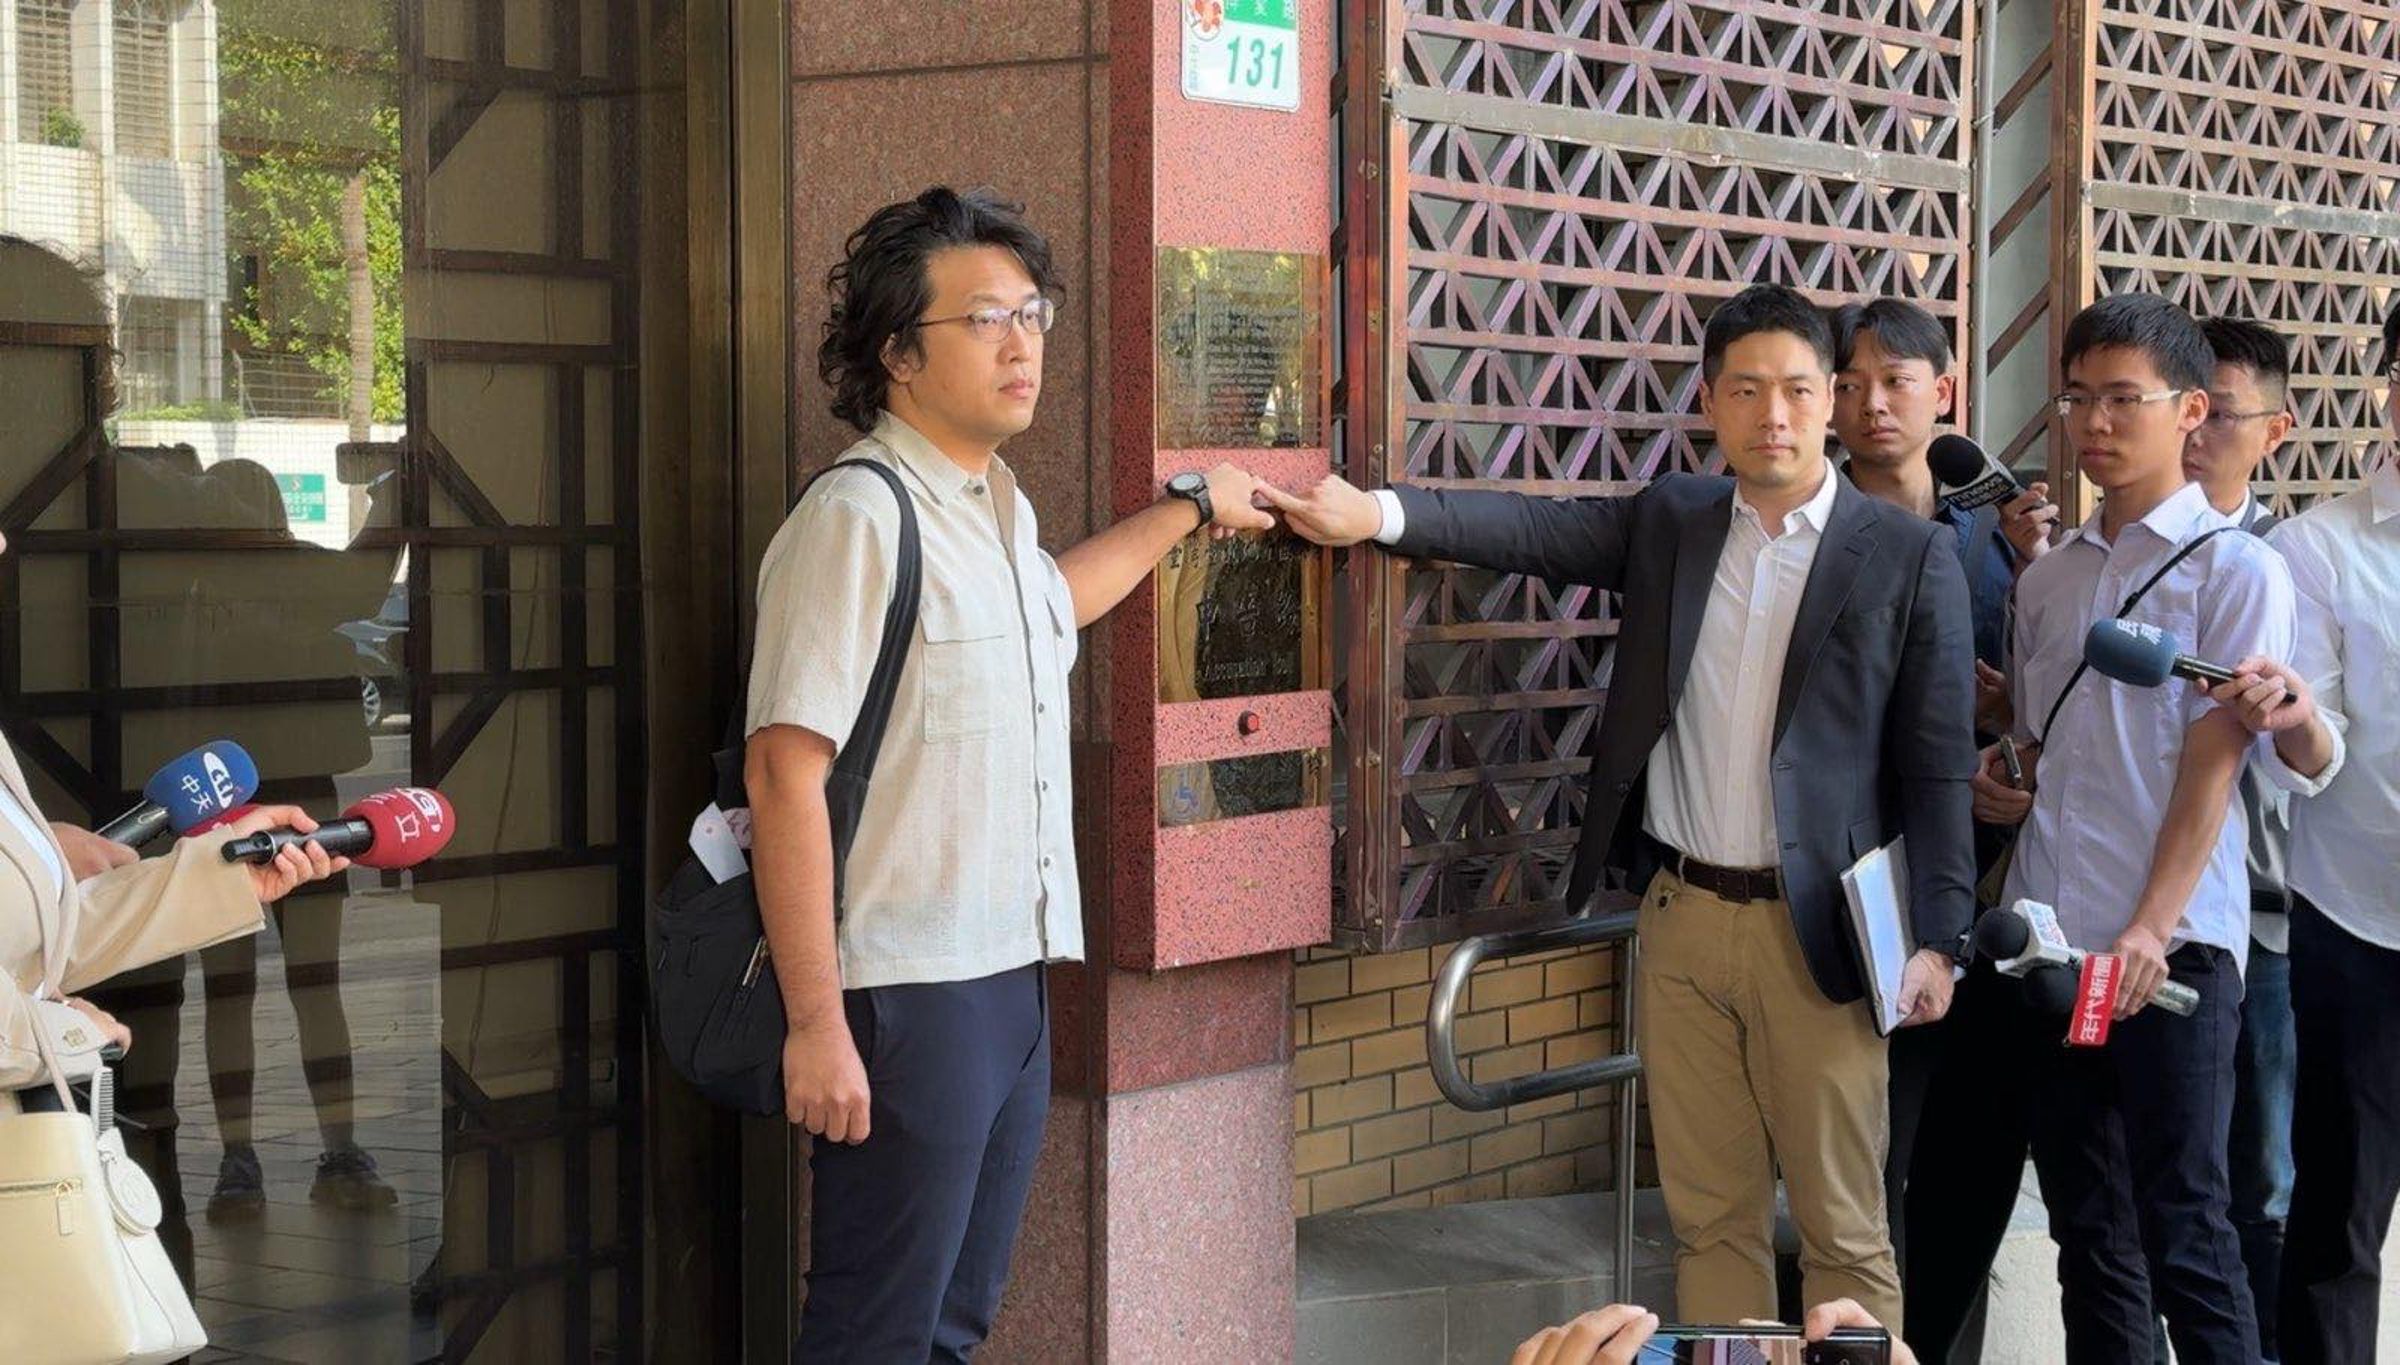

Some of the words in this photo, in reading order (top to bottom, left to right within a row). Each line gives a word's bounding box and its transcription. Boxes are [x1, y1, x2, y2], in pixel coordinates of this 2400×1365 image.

[1227, 36, 1283, 90] 131
[181, 774, 214, 815] 中天
[2079, 956, 2114, 1042] 年代新聞
